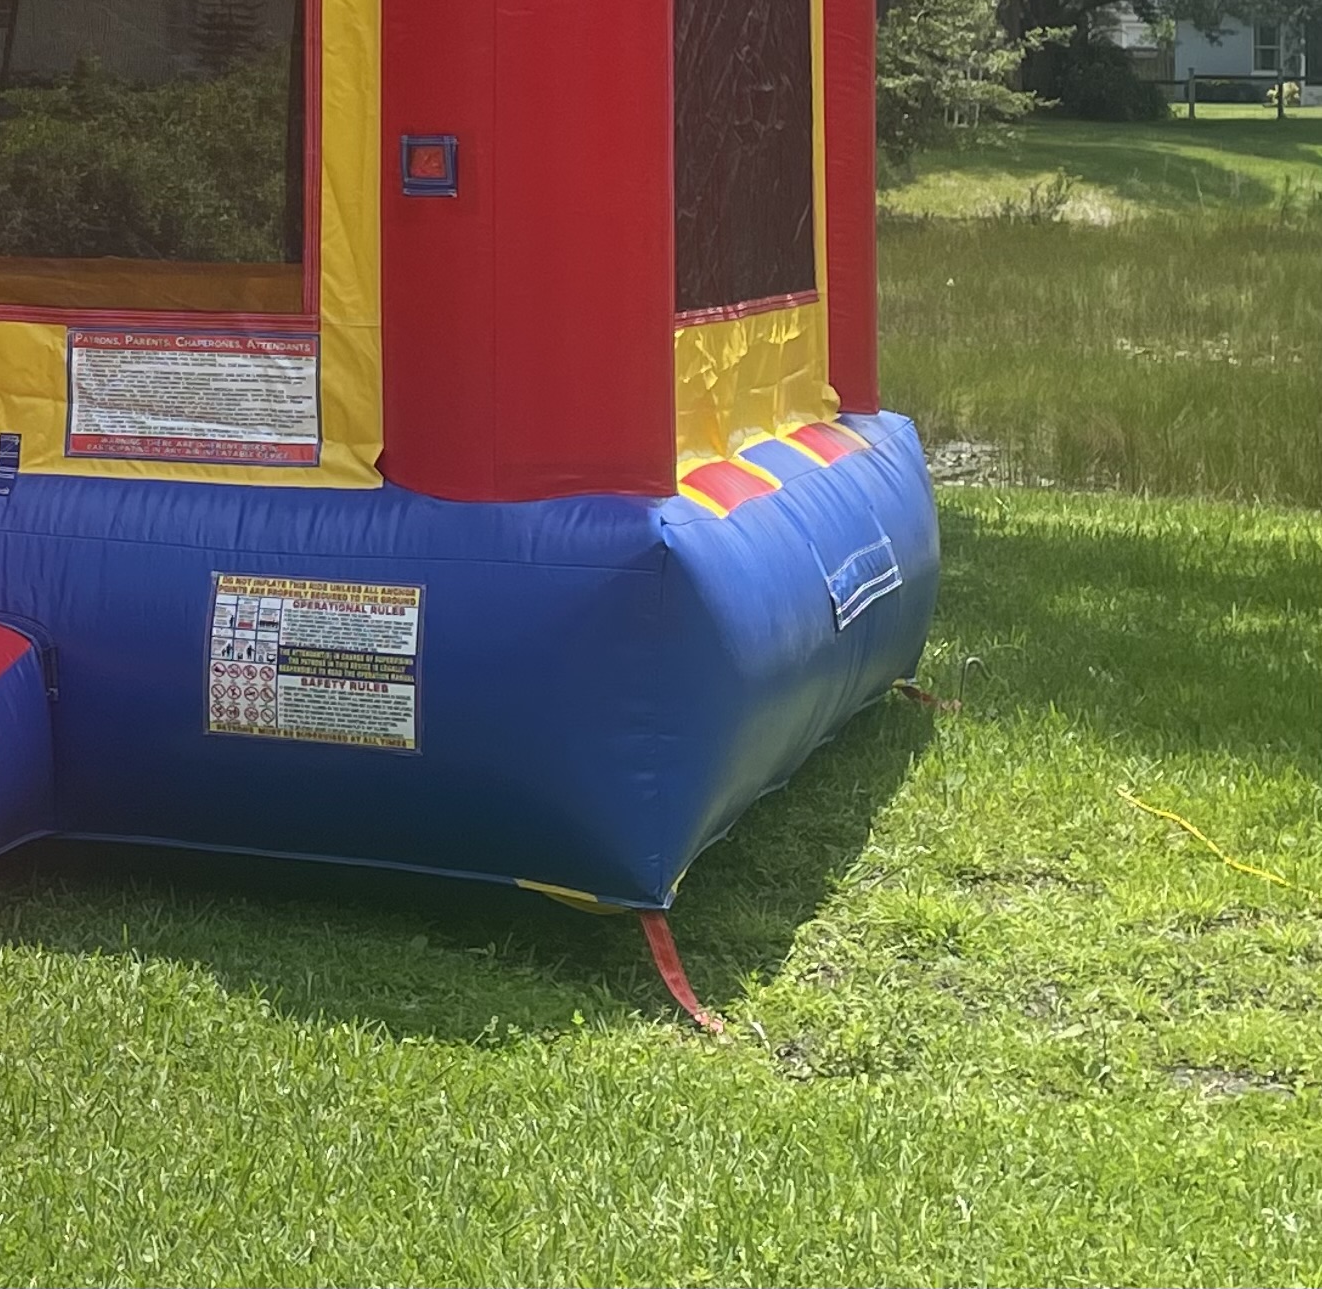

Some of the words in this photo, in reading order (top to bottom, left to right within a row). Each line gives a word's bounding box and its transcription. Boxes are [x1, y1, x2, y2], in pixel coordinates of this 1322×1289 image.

[247, 339, 311, 352] ATTENDANTS
[176, 440, 192, 448] ARE
[222, 576, 234, 584] DO
[235, 577, 251, 586] NOT
[254, 579, 287, 588] INFLATE
[289, 581, 306, 589] THIS
[309, 582, 327, 591] RIDE
[329, 583, 362, 593] UNLESS
[364, 586, 378, 594] ALL
[380, 587, 416, 596] ANCHOR
[219, 585, 248, 594] POINTS
[250, 587, 265, 595] ARE
[267, 588, 310, 598] PROPERLY
[311, 591, 347, 600] SECURED
[350, 593, 360, 601] TO
[362, 594, 378, 603] THE
[380, 596, 416, 606] GROUND
[292, 600, 367, 613] OPERATIONAL
[370, 605, 406, 616] RULES
[301, 677, 346, 689] SAFETY
[350, 681, 389, 693] RULES
